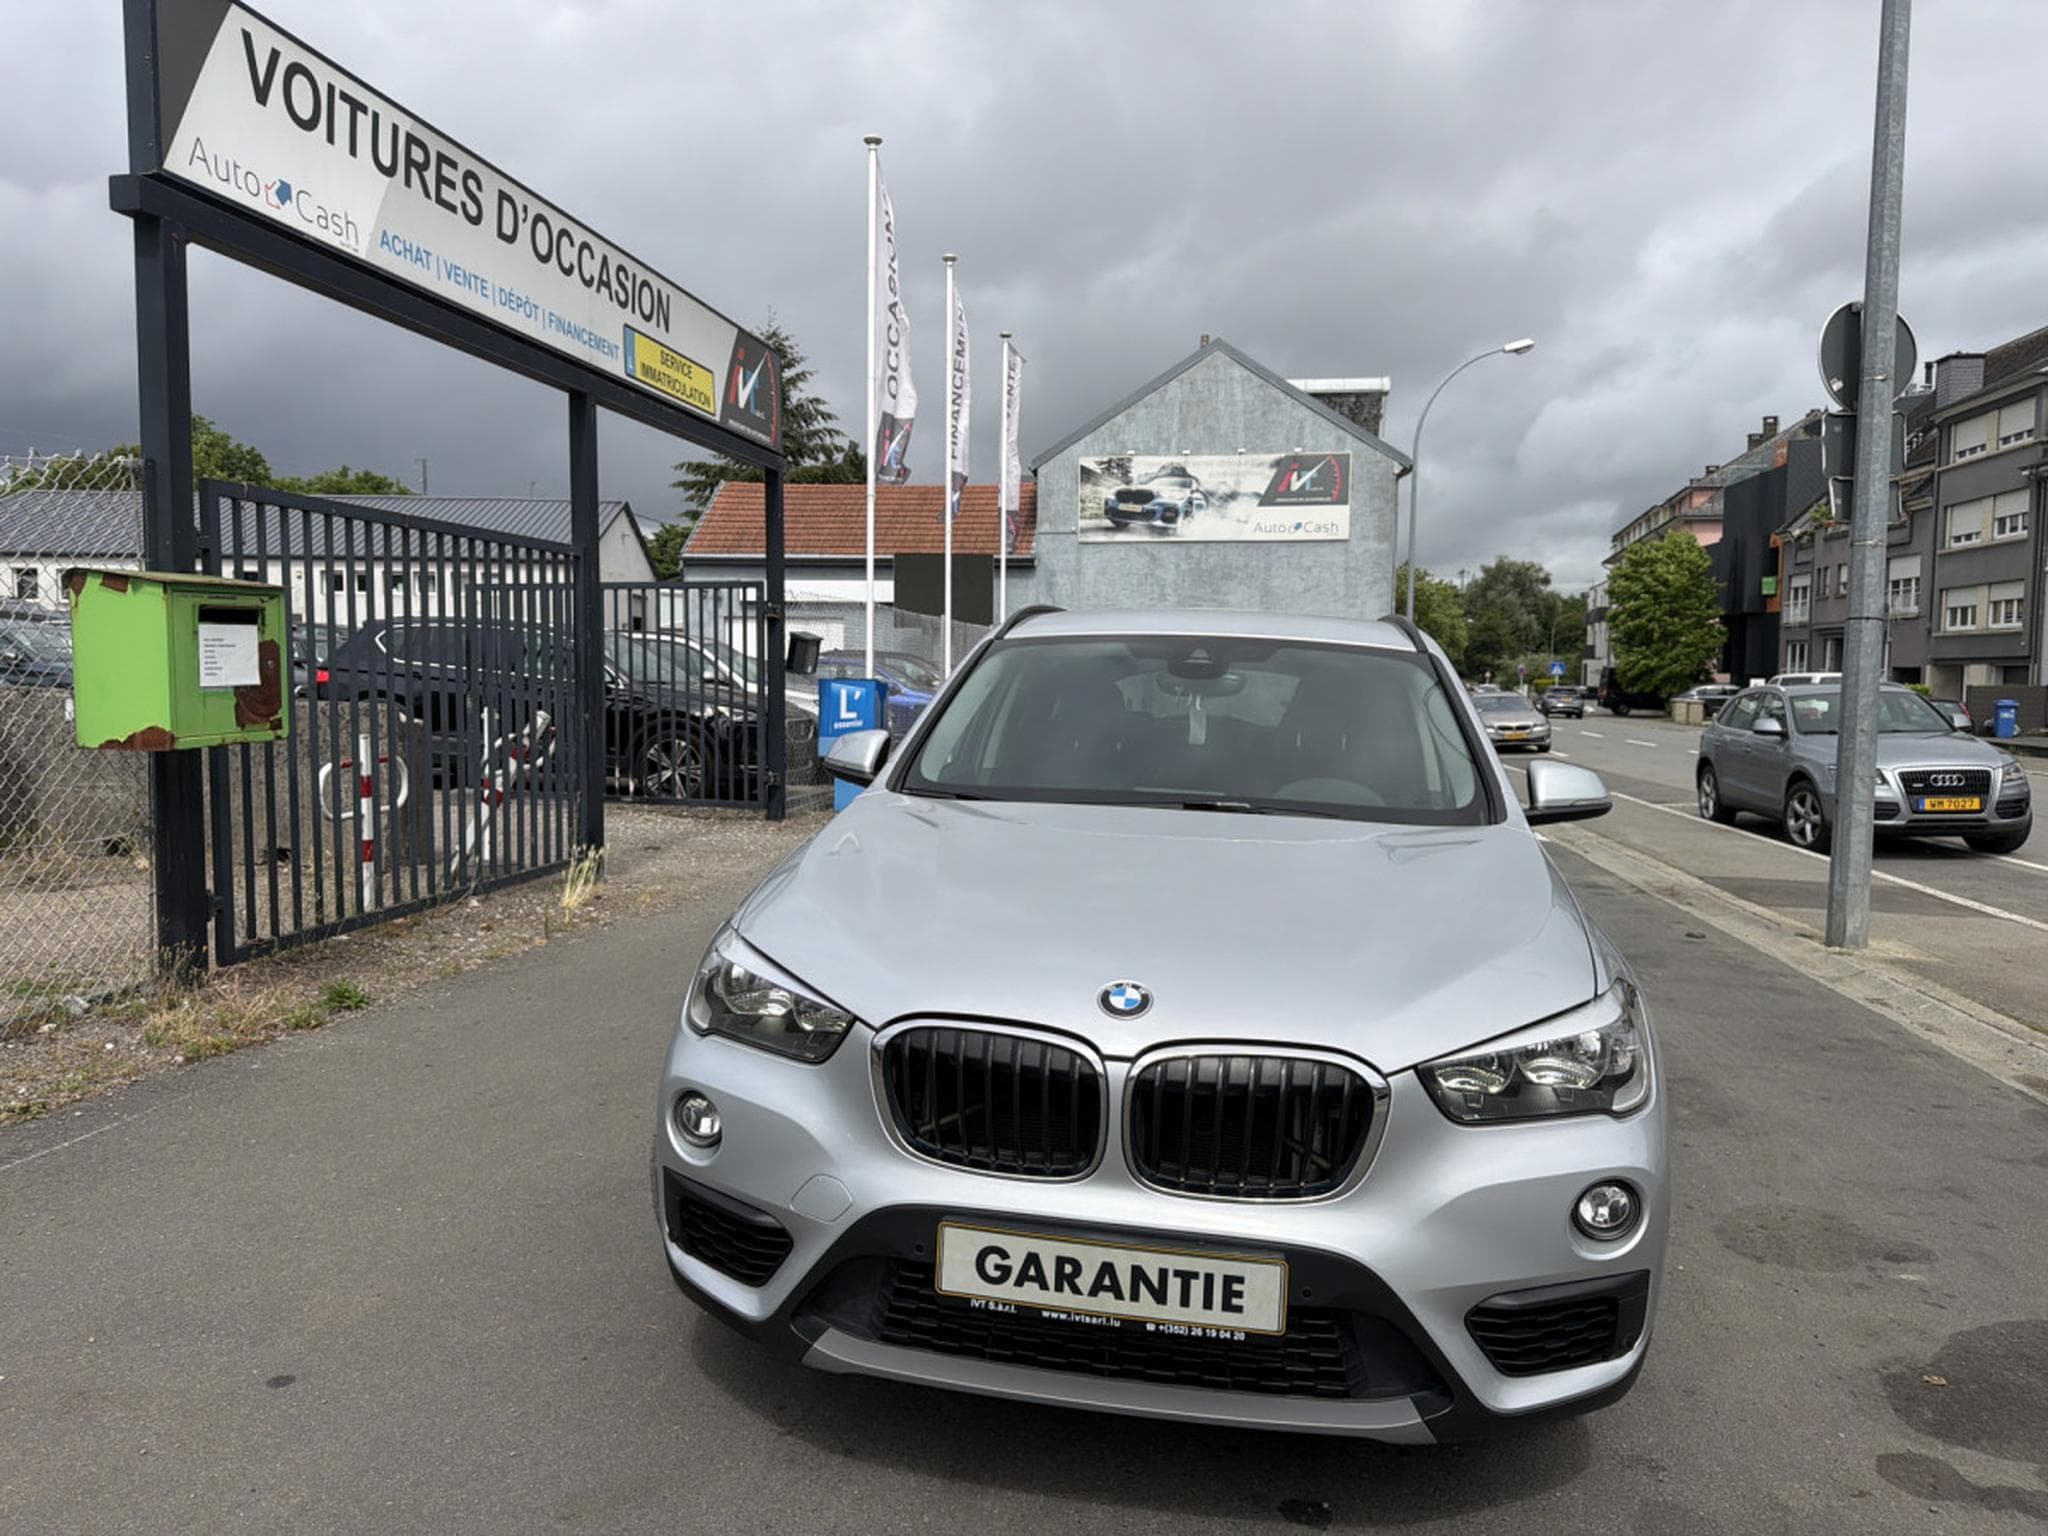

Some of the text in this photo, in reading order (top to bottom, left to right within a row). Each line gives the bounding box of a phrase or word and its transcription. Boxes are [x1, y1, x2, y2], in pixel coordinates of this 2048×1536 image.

[189, 137, 360, 246] Auto Cash
[241, 27, 671, 334] VOITURES D'OCCASION
[379, 229, 432, 271] ACHAT
[443, 261, 489, 299] VENTE
[549, 312, 620, 360] FINANCEMENT
[640, 362, 711, 409] IMMATRICULATION
[660, 350, 693, 380] SERVICE
[1253, 521, 1339, 534] Auto Cash
[975, 1245, 1245, 1314] GARANTIE
